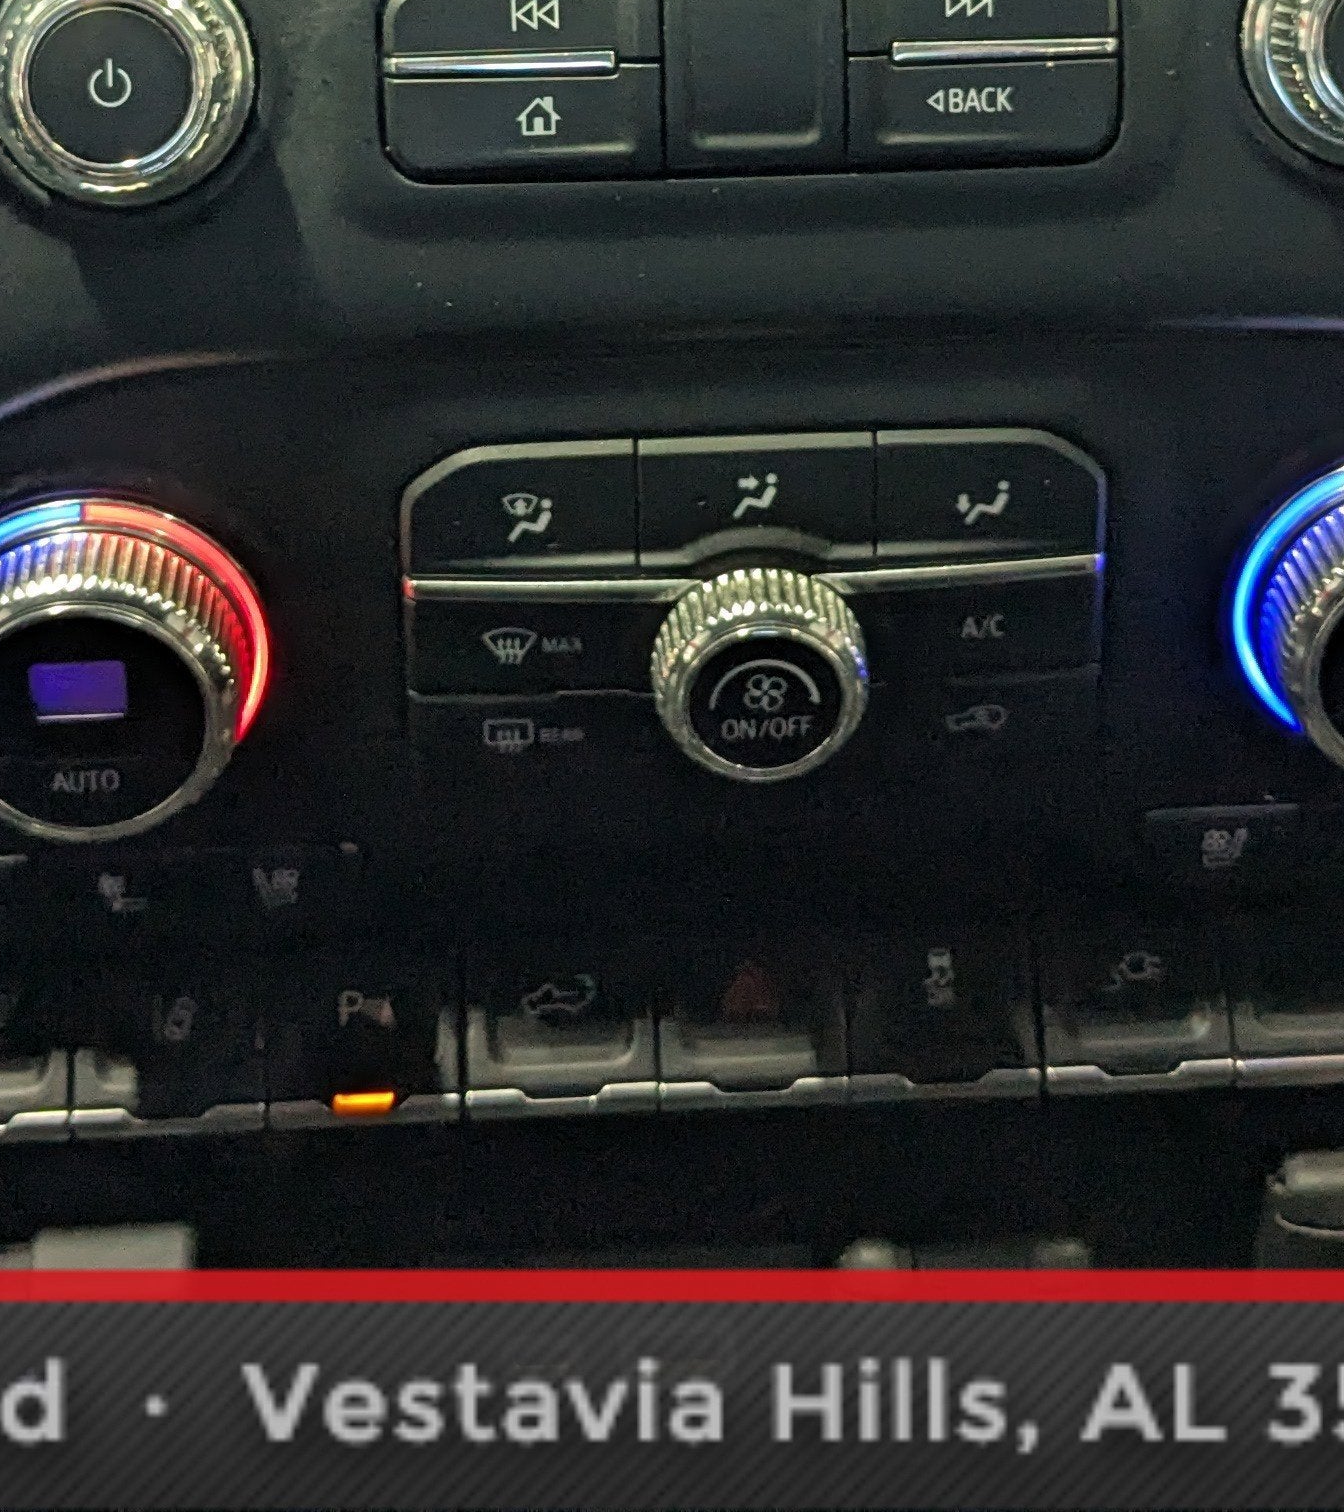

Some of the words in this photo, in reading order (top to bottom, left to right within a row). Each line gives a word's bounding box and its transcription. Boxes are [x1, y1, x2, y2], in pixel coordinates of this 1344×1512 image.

[948, 87, 1014, 114] BACK
[960, 613, 1005, 639] A/C
[721, 715, 814, 741] ON/OFF
[50, 768, 121, 793] AUTO
